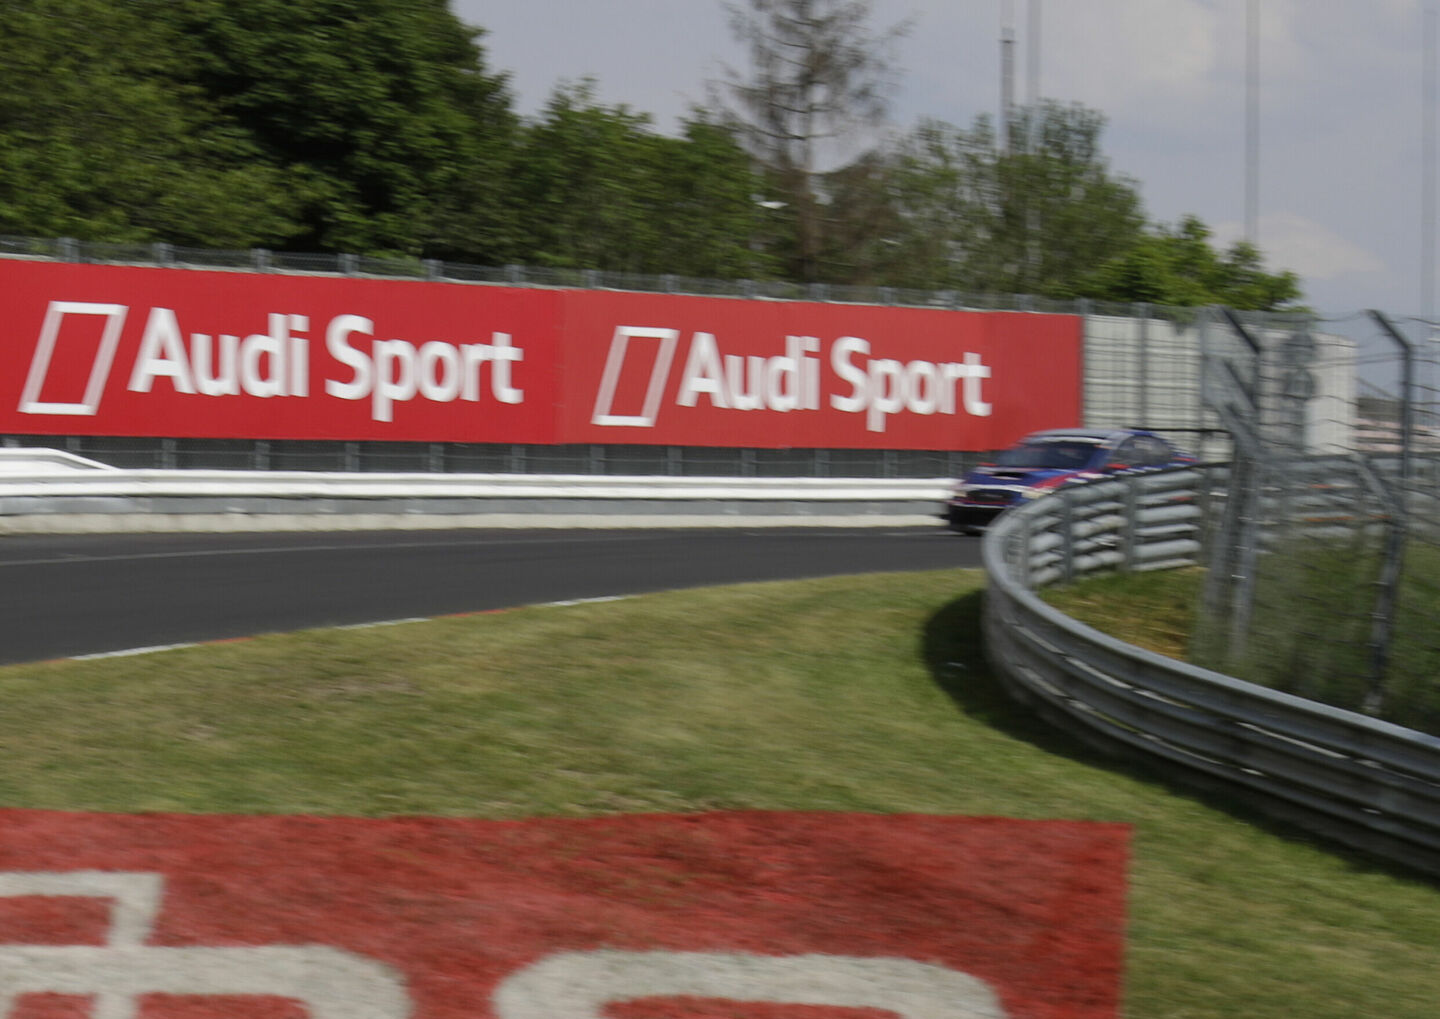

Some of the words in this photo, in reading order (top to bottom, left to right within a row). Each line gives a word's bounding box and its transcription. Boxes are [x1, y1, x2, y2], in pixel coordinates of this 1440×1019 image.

[128, 307, 309, 398] Audi
[325, 314, 524, 422] Sport
[677, 332, 819, 412] Audi
[829, 336, 992, 432] Sport
